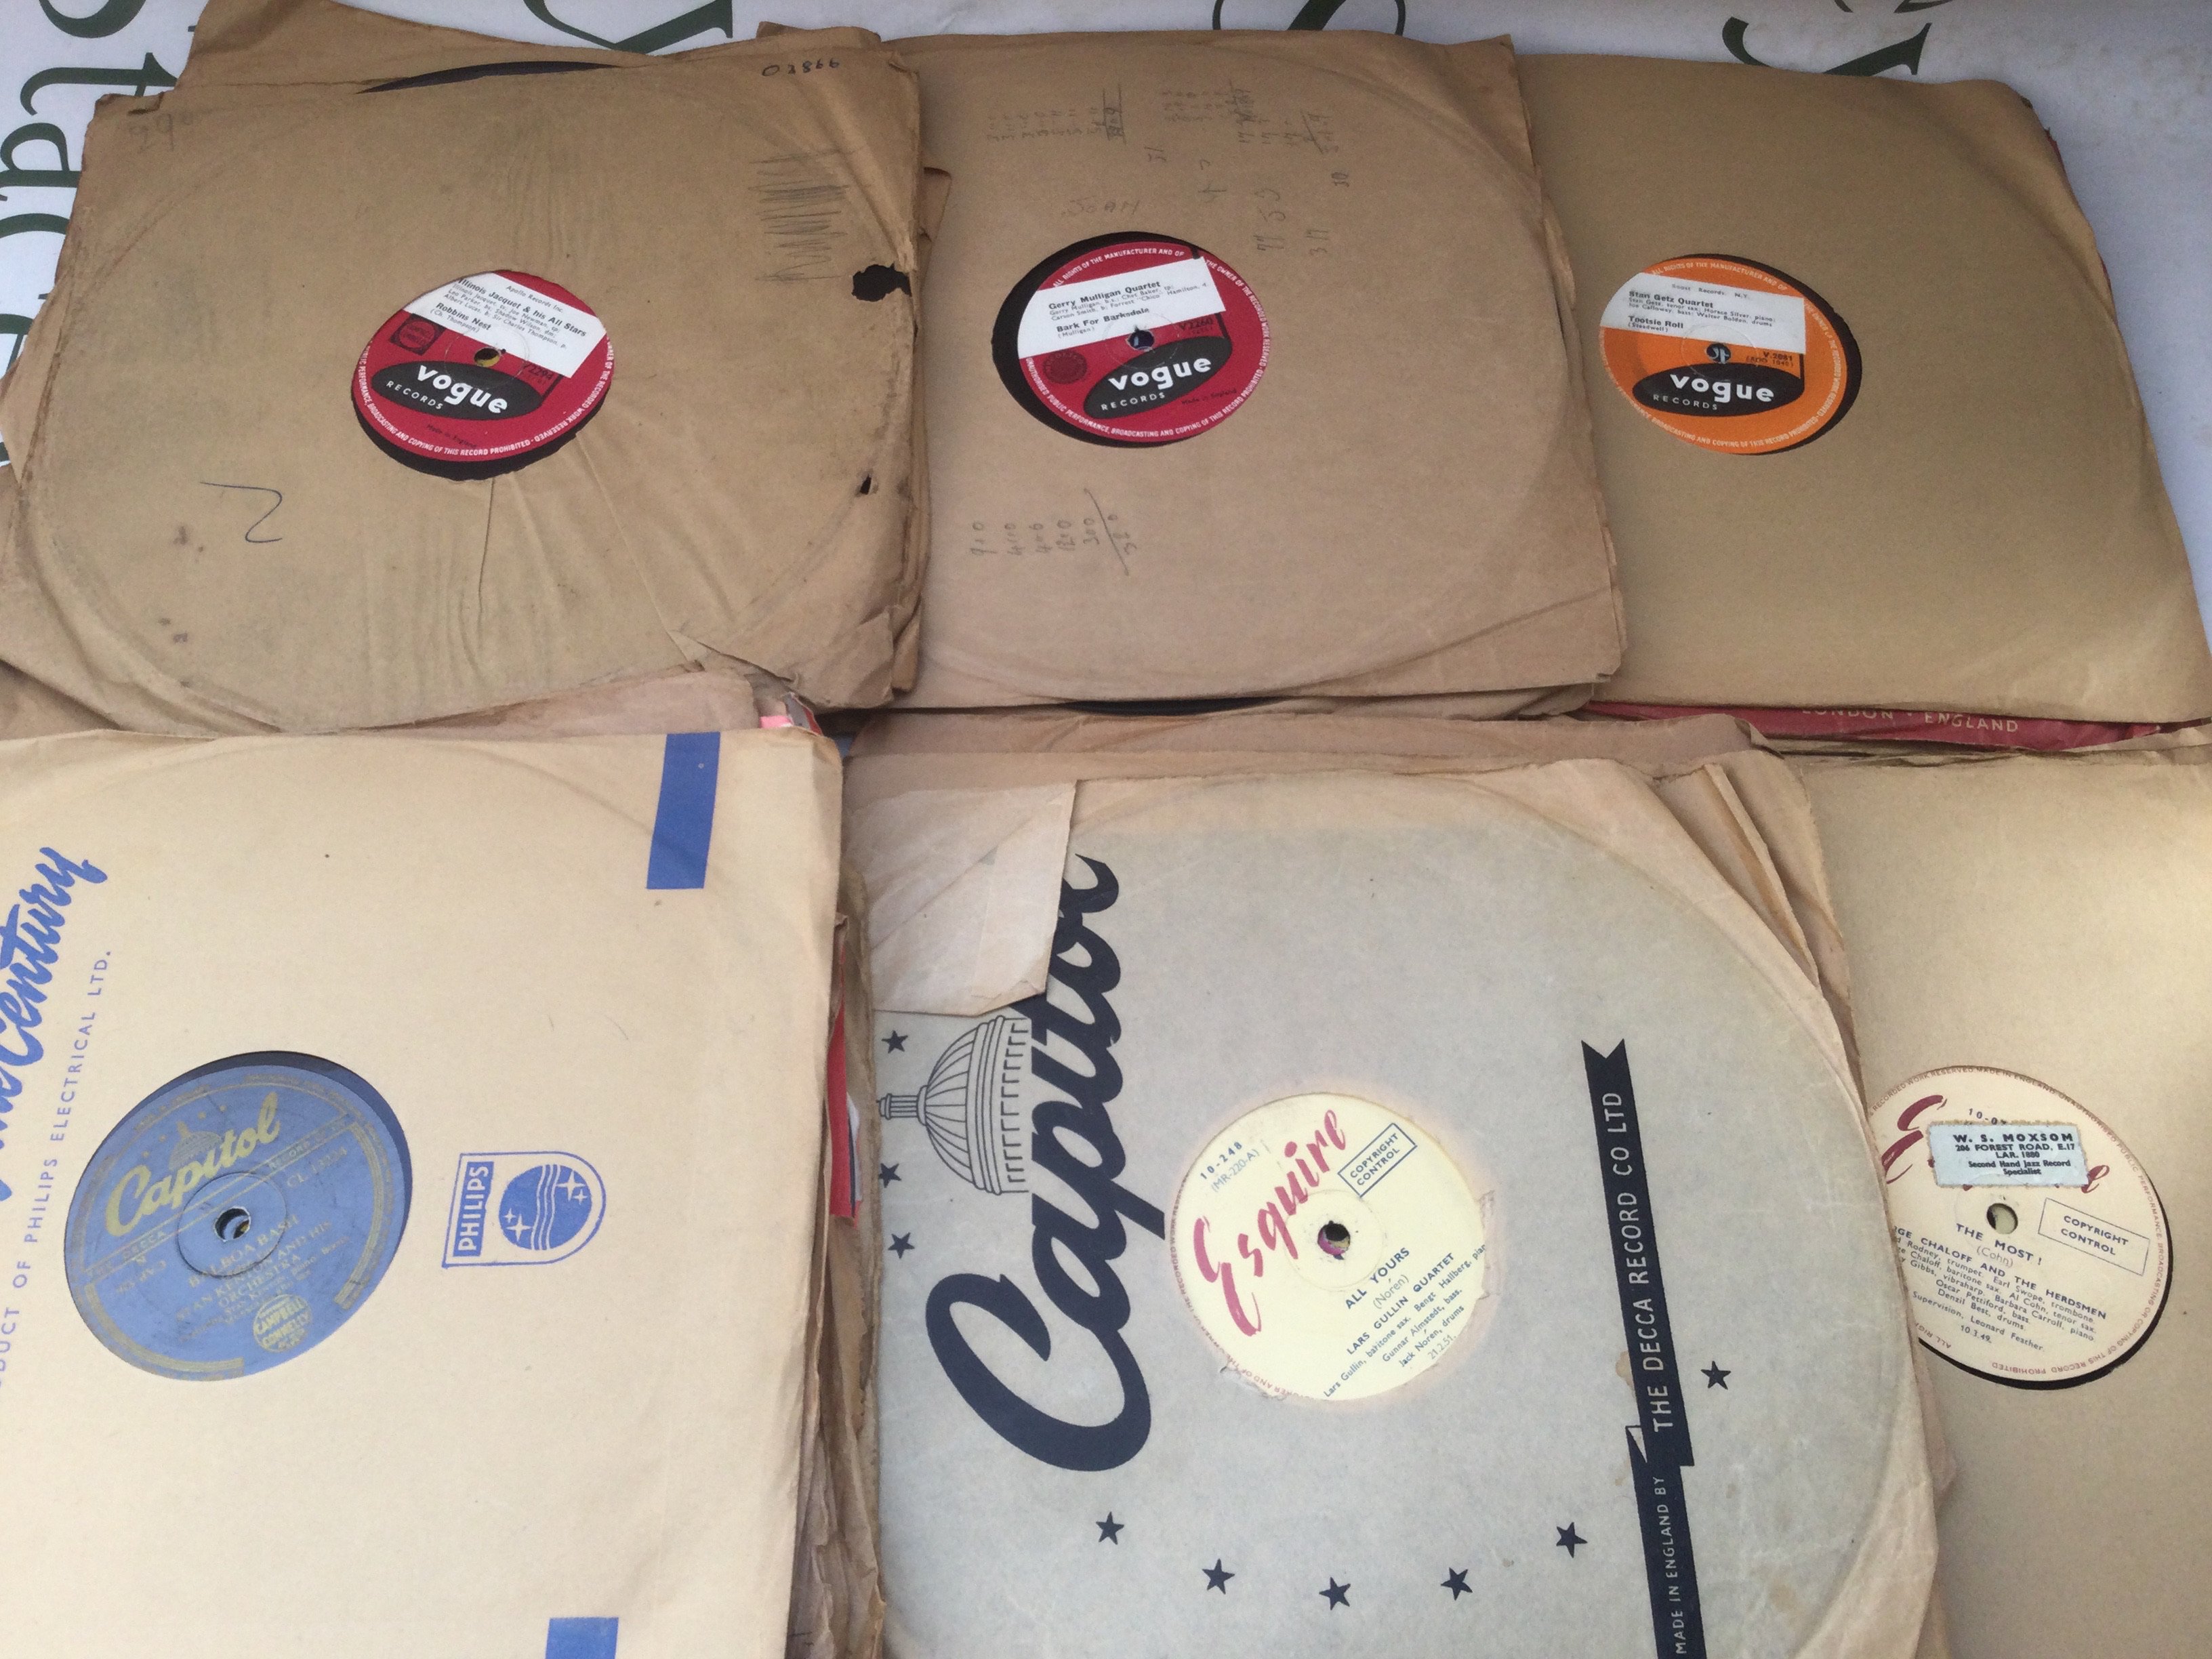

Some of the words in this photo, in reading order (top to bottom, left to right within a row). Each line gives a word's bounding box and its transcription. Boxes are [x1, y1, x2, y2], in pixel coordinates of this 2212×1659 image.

[1080, 289, 1122, 305] Mulligan
[1125, 281, 1161, 294] Quartet
[1629, 291, 1652, 300] Stan
[1654, 293, 1675, 303] Getz
[1677, 298, 1714, 309] Quartet
[436, 302, 470, 322] Robbins
[472, 316, 492, 331] Nest
[489, 291, 521, 309] Jacquet
[523, 305, 531, 314] &
[533, 309, 547, 321] his
[548, 316, 562, 327] All
[564, 322, 587, 338] Stars
[1056, 322, 1080, 333] Bark
[1083, 318, 1100, 328] For
[1628, 314, 1662, 327] Tootsie
[1664, 321, 1684, 329] Roll
[417, 365, 508, 413] vogue
[1108, 358, 1212, 390] vogue
[1669, 373, 1775, 403] vogue
[386, 380, 444, 410] RECORDS
[1101, 392, 1165, 411] RECORDS
[1653, 394, 1718, 411] RECORDS
[1923, 712, 2019, 733] ENGLAND
[1872, 1083, 1906, 1111] RECORDED
[12, 1261, 31, 1289] OF
[24, 1158, 58, 1244] PHILIPS
[49, 1011, 96, 1142] ELECTRICAL
[87, 949, 112, 997] LTD.
[1602, 1092, 1628, 1134] LTD
[1953, 1134, 1973, 1143] W.
[1980, 1134, 1994, 1143] S.
[2003, 1133, 2074, 1143] MOXSOM
[104, 1091, 281, 1237] Capitol
[1350, 1132, 1399, 1179] COPYRIGHT
[1356, 1147, 1401, 1186] CONTROL
[1610, 1145, 1633, 1177] CO
[457, 1166, 489, 1251] PHILIPS
[1193, 1109, 1347, 1337] Esquire
[1616, 1191, 1650, 1286] RECORD
[1956, 1223, 1984, 1242] THE
[1994, 1240, 2034, 1262] MOST
[2061, 1228, 2116, 1256] CONTROL
[2064, 1215, 2129, 1246] COPYRIGHT
[1976, 1245, 2014, 1269] (Cohn)
[1345, 1288, 1368, 1310] ALL
[1369, 1247, 1410, 1284] YOURS
[1921, 1237, 1973, 1263] CHALOFF
[1980, 1263, 2006, 1277] AND
[2014, 1275, 2037, 1290] THE
[2045, 1289, 2107, 1320] HERDSMEN
[1936, 1279, 1961, 1295] Oscar
[1993, 1275, 2011, 1289] Earl
[1347, 1332, 1370, 1355] LARS
[1373, 1296, 1409, 1330] GULLIN
[1413, 1252, 1455, 1292] QUARTET
[1938, 1288, 1966, 1305] Denzil
[1946, 1266, 1982, 1286] baritone
[2009, 1292, 2020, 1301] Al
[2053, 1311, 2076, 1326] tenor
[1994, 1294, 2028, 1315] Barbara
[1399, 1351, 1416, 1368] Jack
[1442, 1305, 1465, 1328] drums
[1632, 1297, 1665, 1372] DECCA
[1970, 1315, 2006, 1336] Leonard
[1323, 1381, 1342, 1397] Lars
[1365, 1330, 1397, 1359] baritone
[1414, 1291, 1437, 1312] Bengt
[1382, 1336, 1409, 1362] Gunnar
[1647, 1385, 1674, 1434] THE
[1652, 1476, 1666, 1496] BY
[1656, 1504, 1679, 1578] ENGLAND
[1668, 1585, 1682, 1602] IN
[1671, 1610, 1687, 1655] MADE
